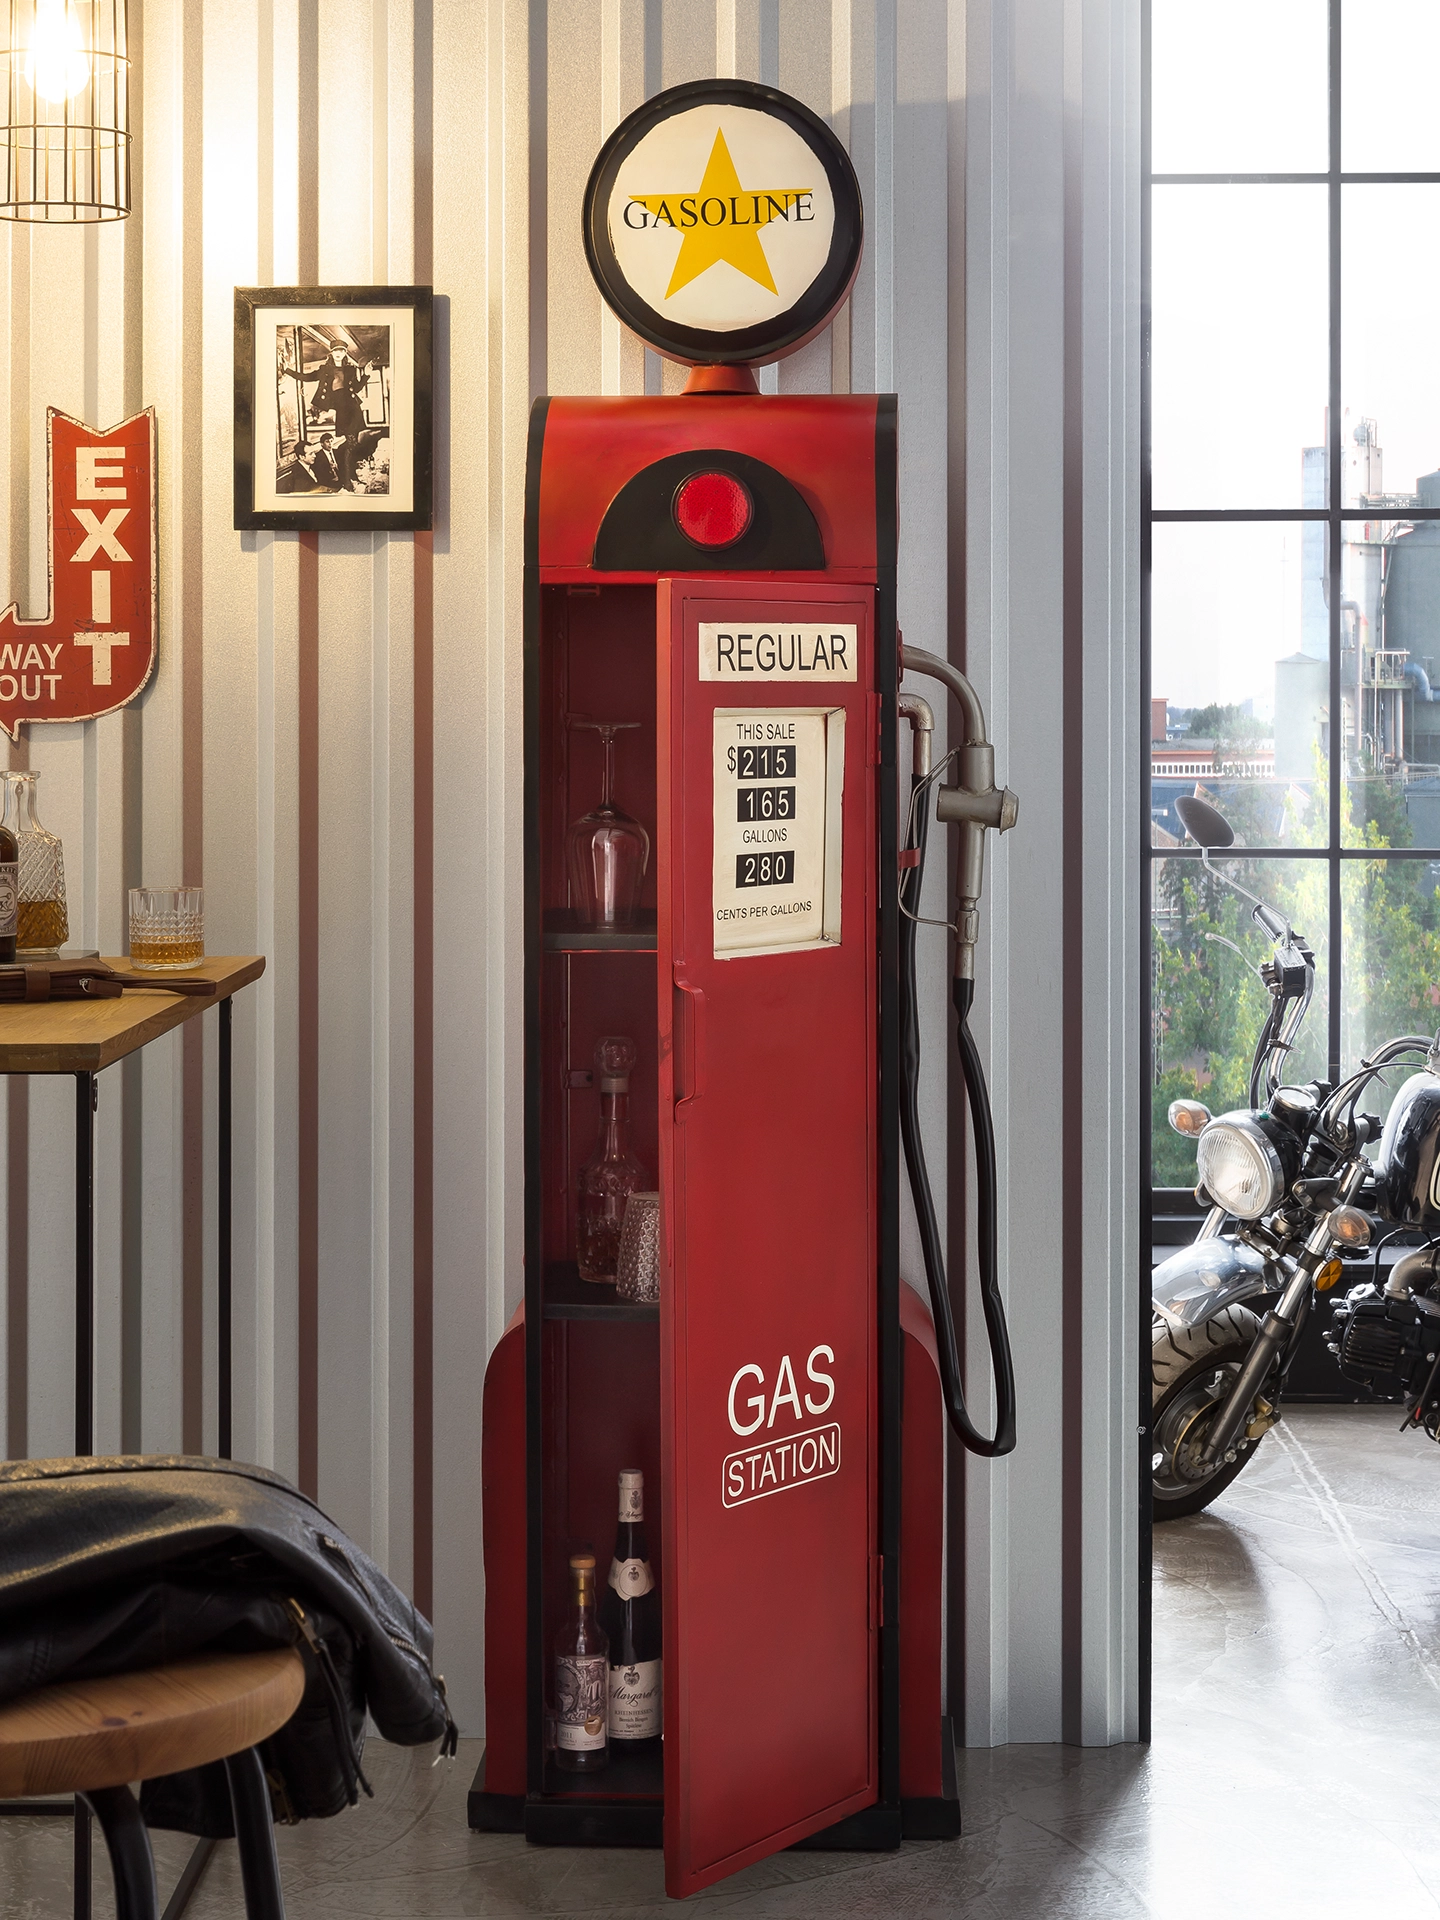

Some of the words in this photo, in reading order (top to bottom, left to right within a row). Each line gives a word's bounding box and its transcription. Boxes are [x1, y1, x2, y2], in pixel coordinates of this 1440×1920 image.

[623, 193, 816, 229] GASOLINE
[69, 446, 134, 686] EXIT
[0, 643, 64, 670] WAY
[717, 633, 849, 672] REGULAR
[0, 674, 63, 701] OUT
[736, 724, 763, 740] THIS
[766, 723, 796, 740] SALE
[746, 790, 789, 818] 165
[742, 827, 788, 844] GALLONS
[744, 855, 786, 883] 280
[716, 907, 747, 921] CENTS
[749, 905, 768, 917] PER
[770, 900, 812, 916] GALLONS
[727, 1344, 836, 1437] GAS
[727, 1431, 836, 1498] STATION
